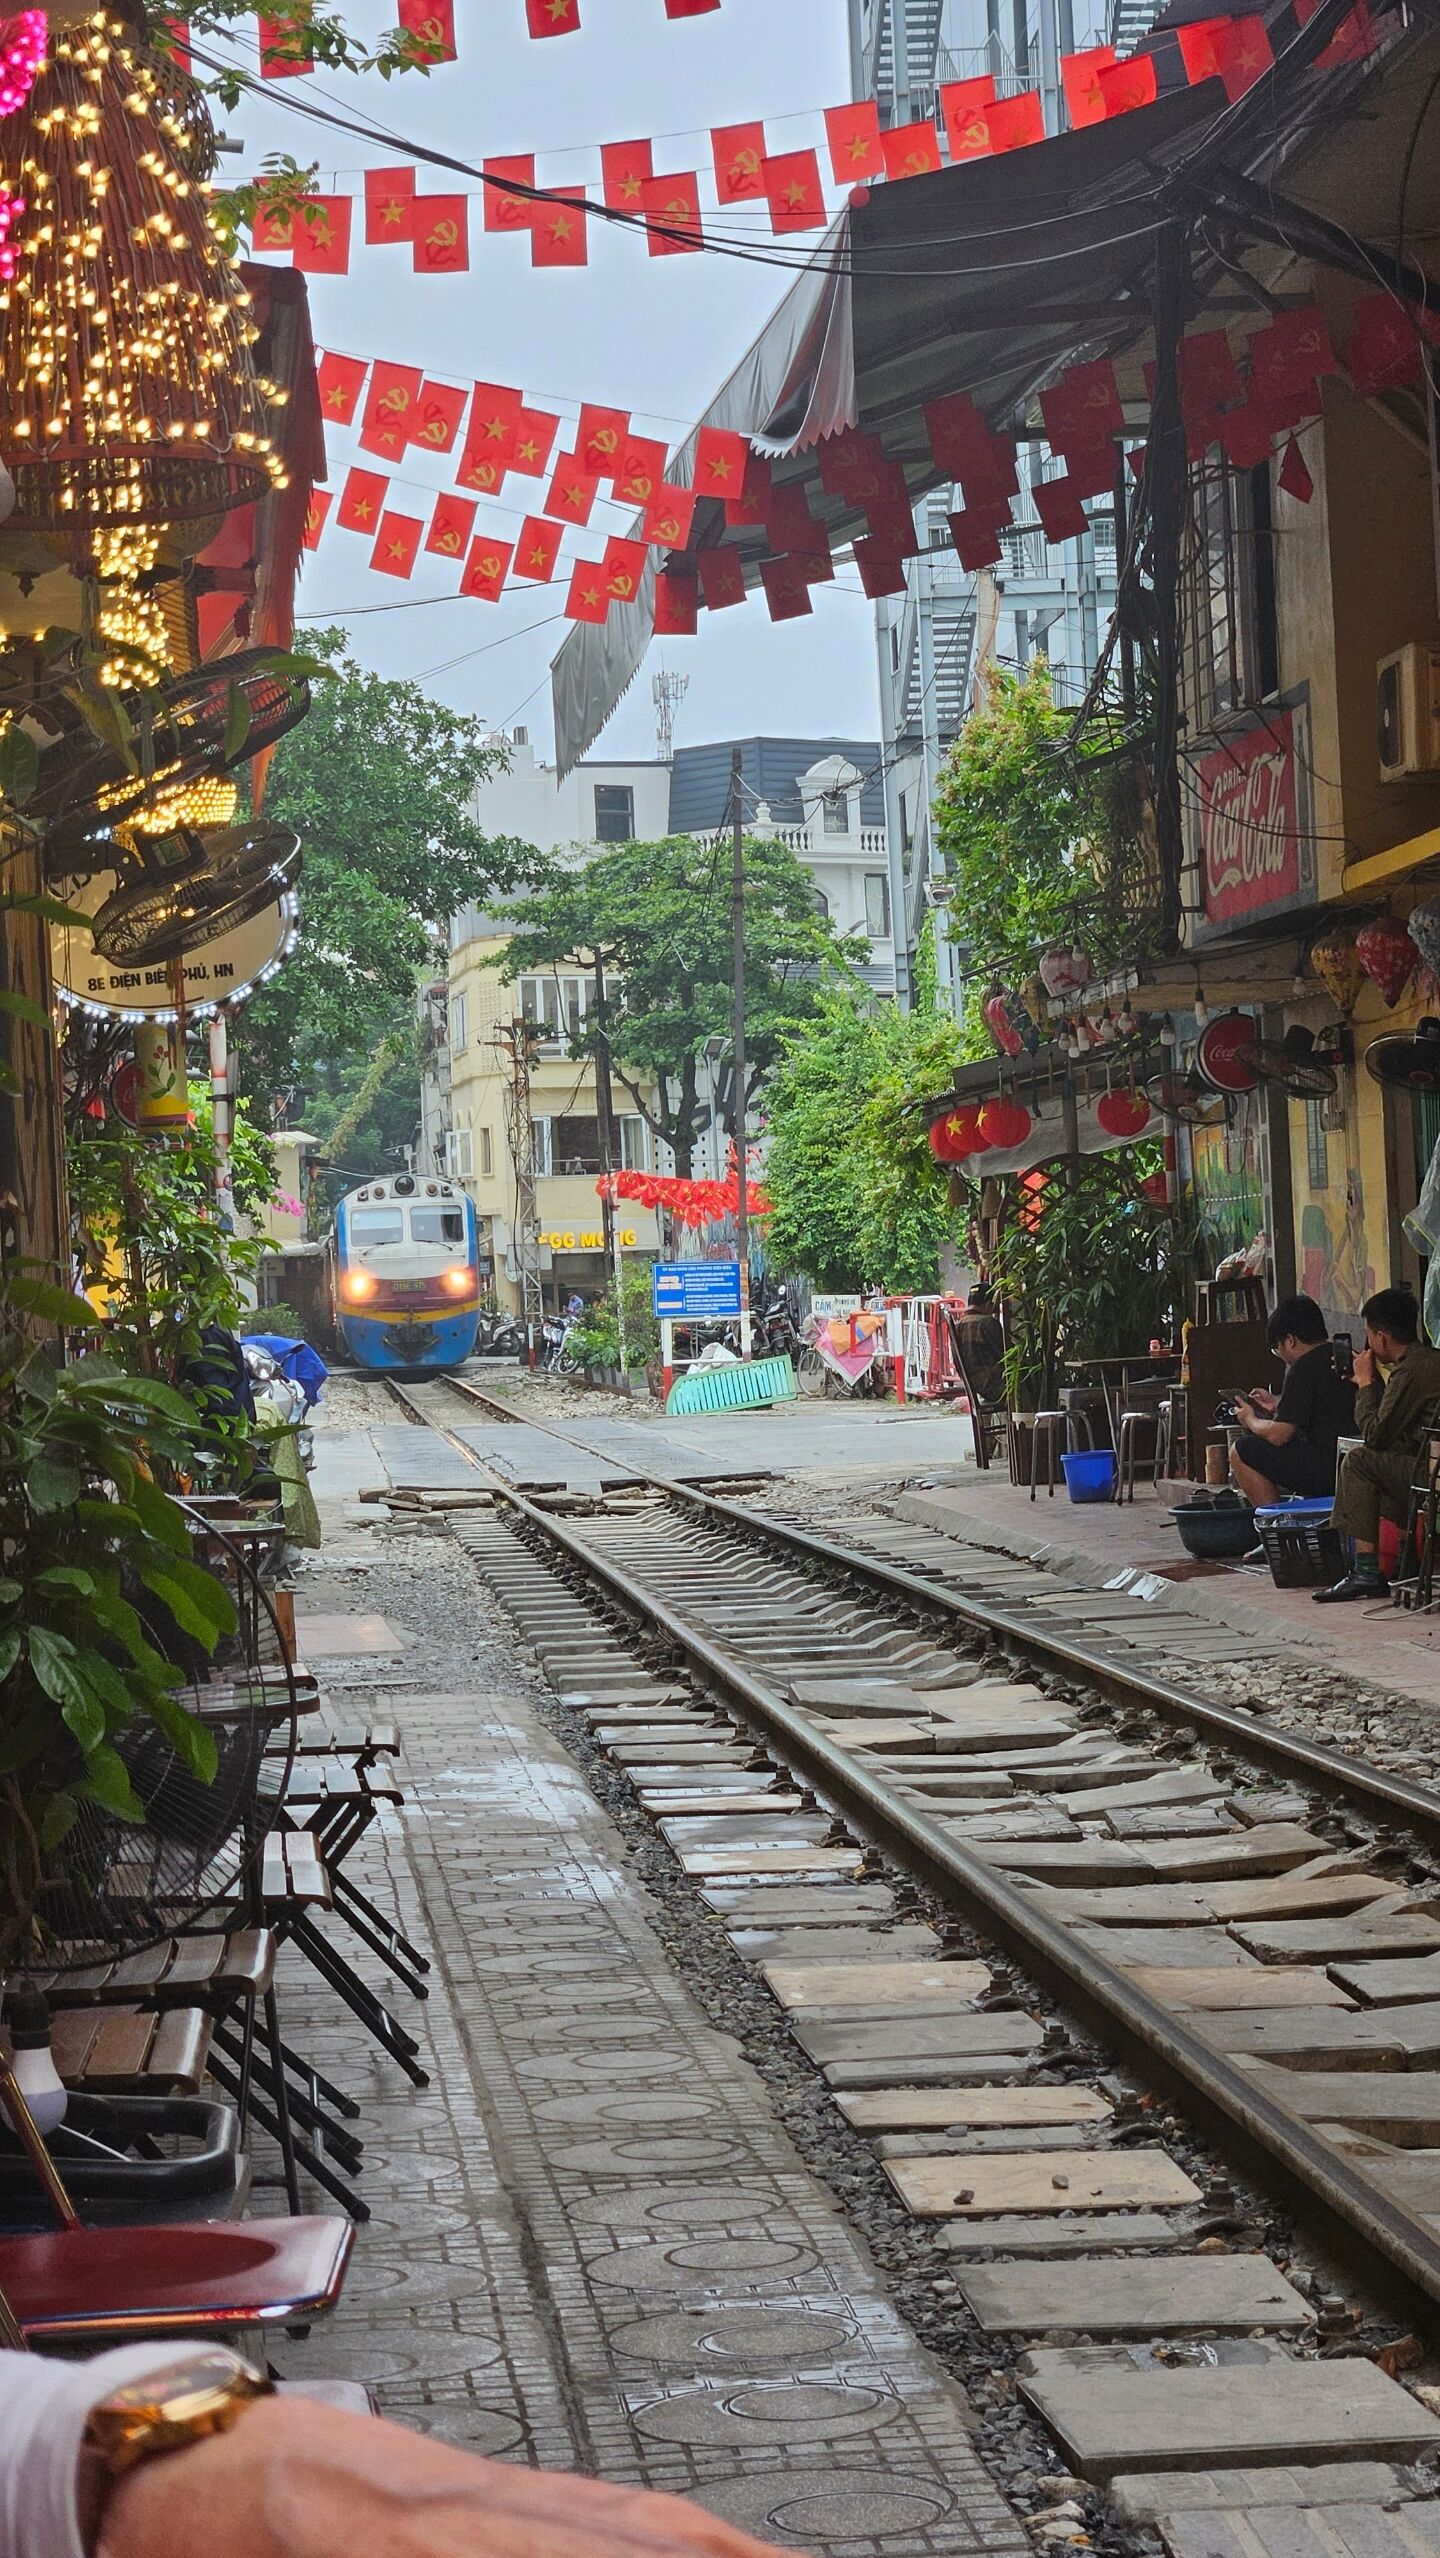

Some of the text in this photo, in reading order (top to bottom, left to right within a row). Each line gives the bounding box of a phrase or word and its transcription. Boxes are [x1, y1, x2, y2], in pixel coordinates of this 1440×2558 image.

[87, 977, 105, 992] 8E
[109, 971, 141, 990] ĐIỆN
[145, 968, 168, 985] BIÊ
[213, 963, 234, 978] HN
[537, 1228, 637, 1249] EGG MOG
